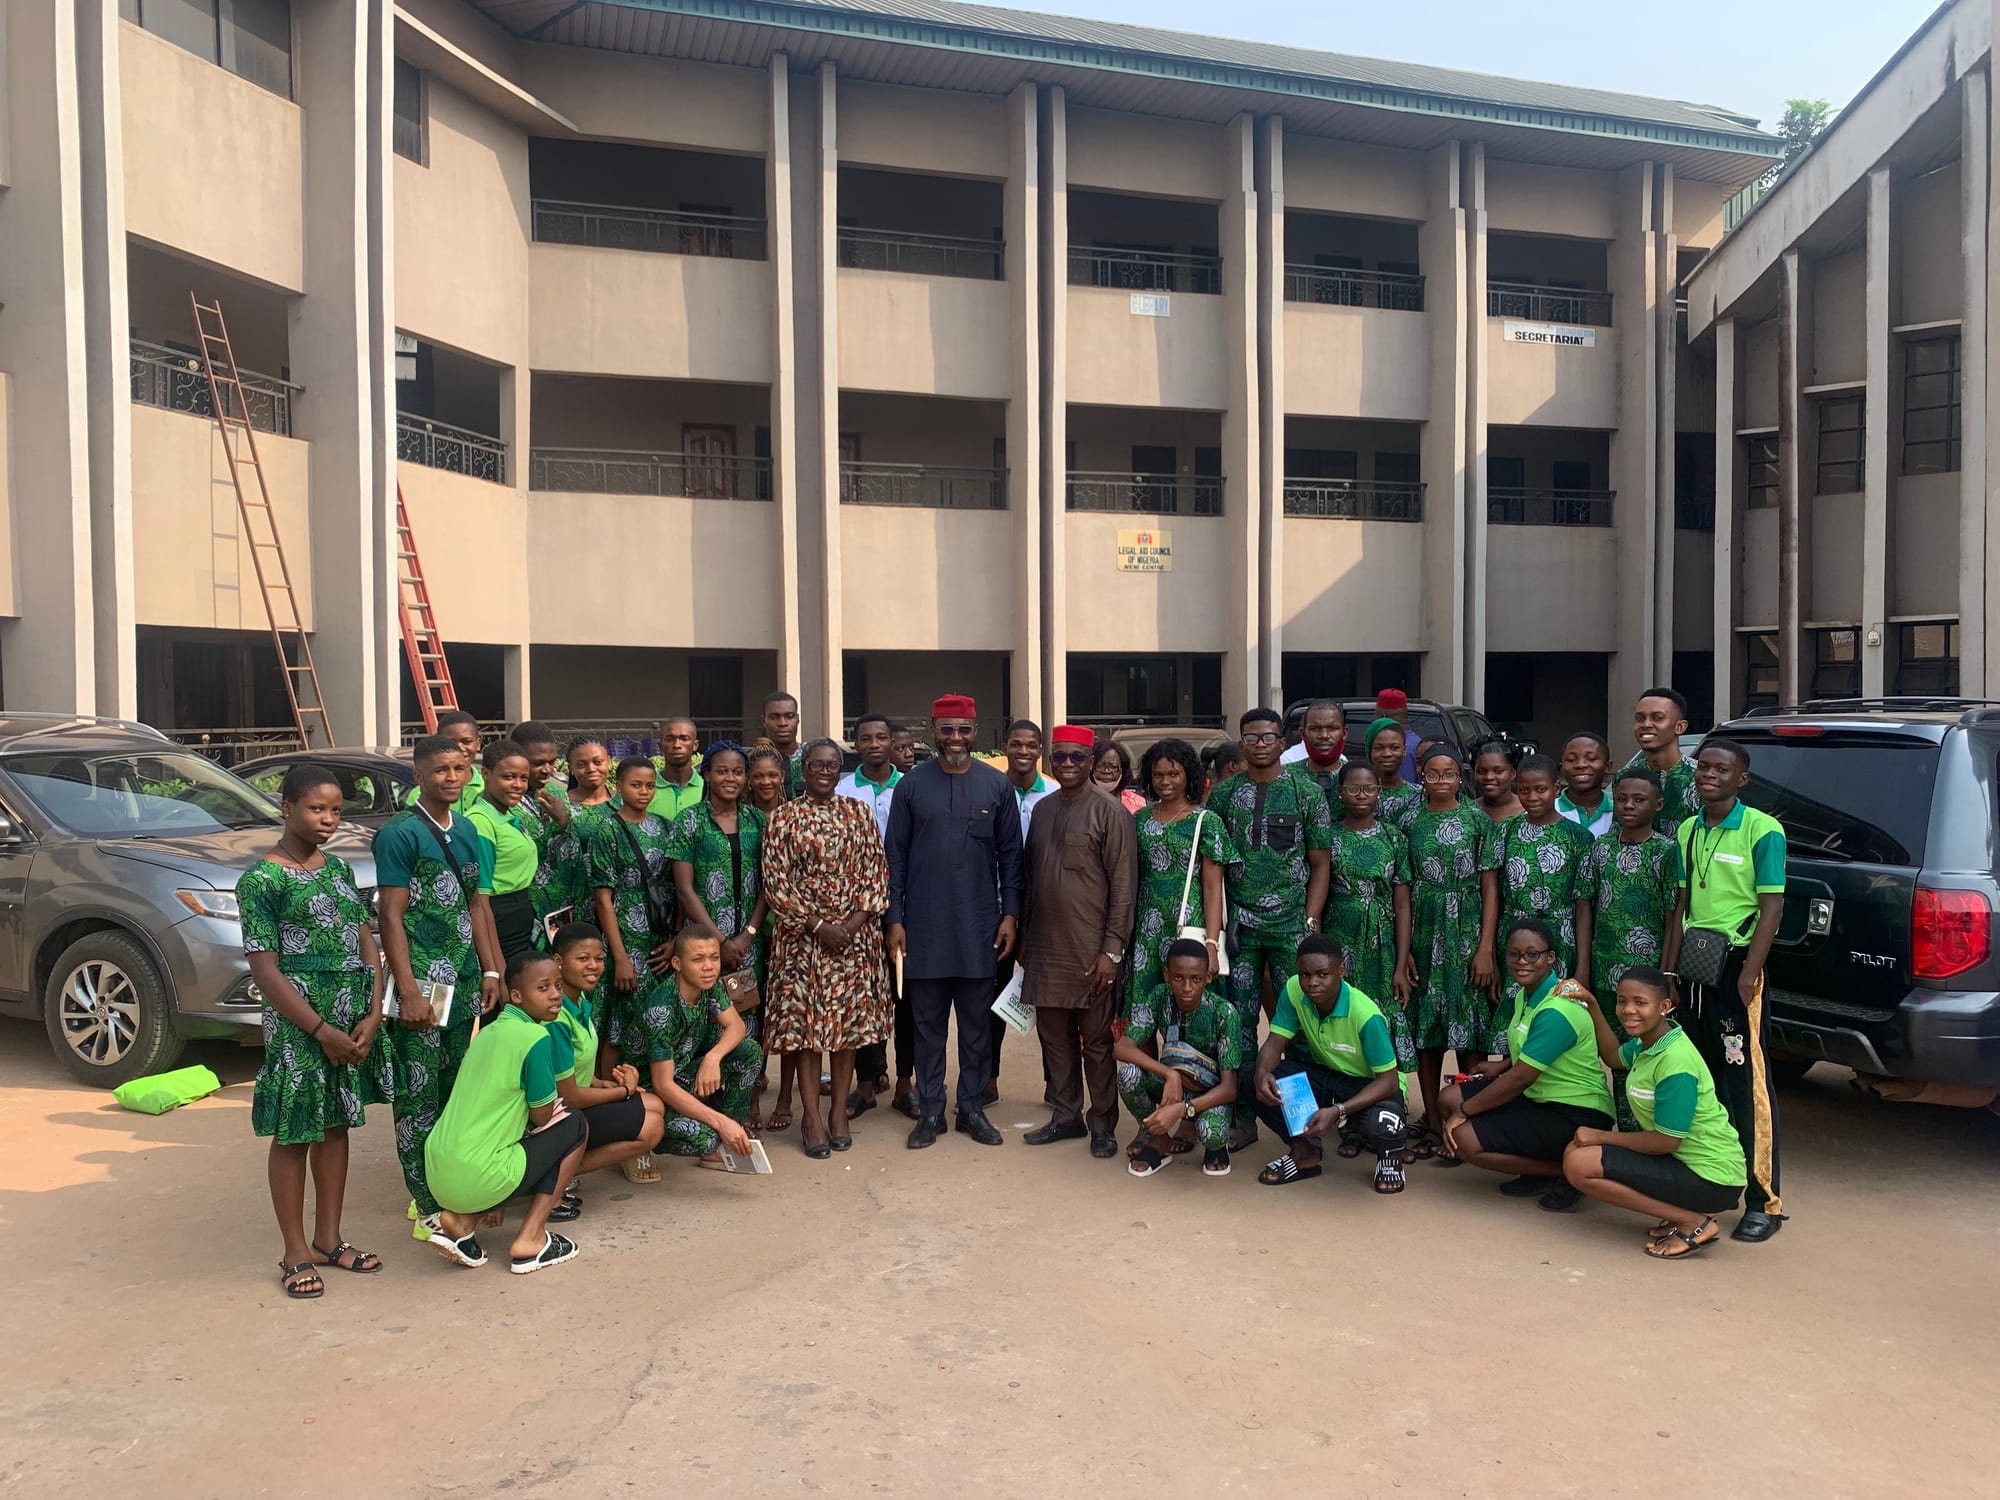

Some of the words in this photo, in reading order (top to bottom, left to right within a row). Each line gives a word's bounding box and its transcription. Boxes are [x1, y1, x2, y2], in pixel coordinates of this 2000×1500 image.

[1515, 331, 1584, 345] SECRETARIAT
[1118, 546, 1137, 555] LEGAL
[1139, 547, 1149, 555] AID
[1150, 547, 1171, 556] COUNCIL
[1127, 555, 1134, 564] OF
[1136, 556, 1159, 564] NIGERIA
[1849, 950, 1897, 969] PILOT
